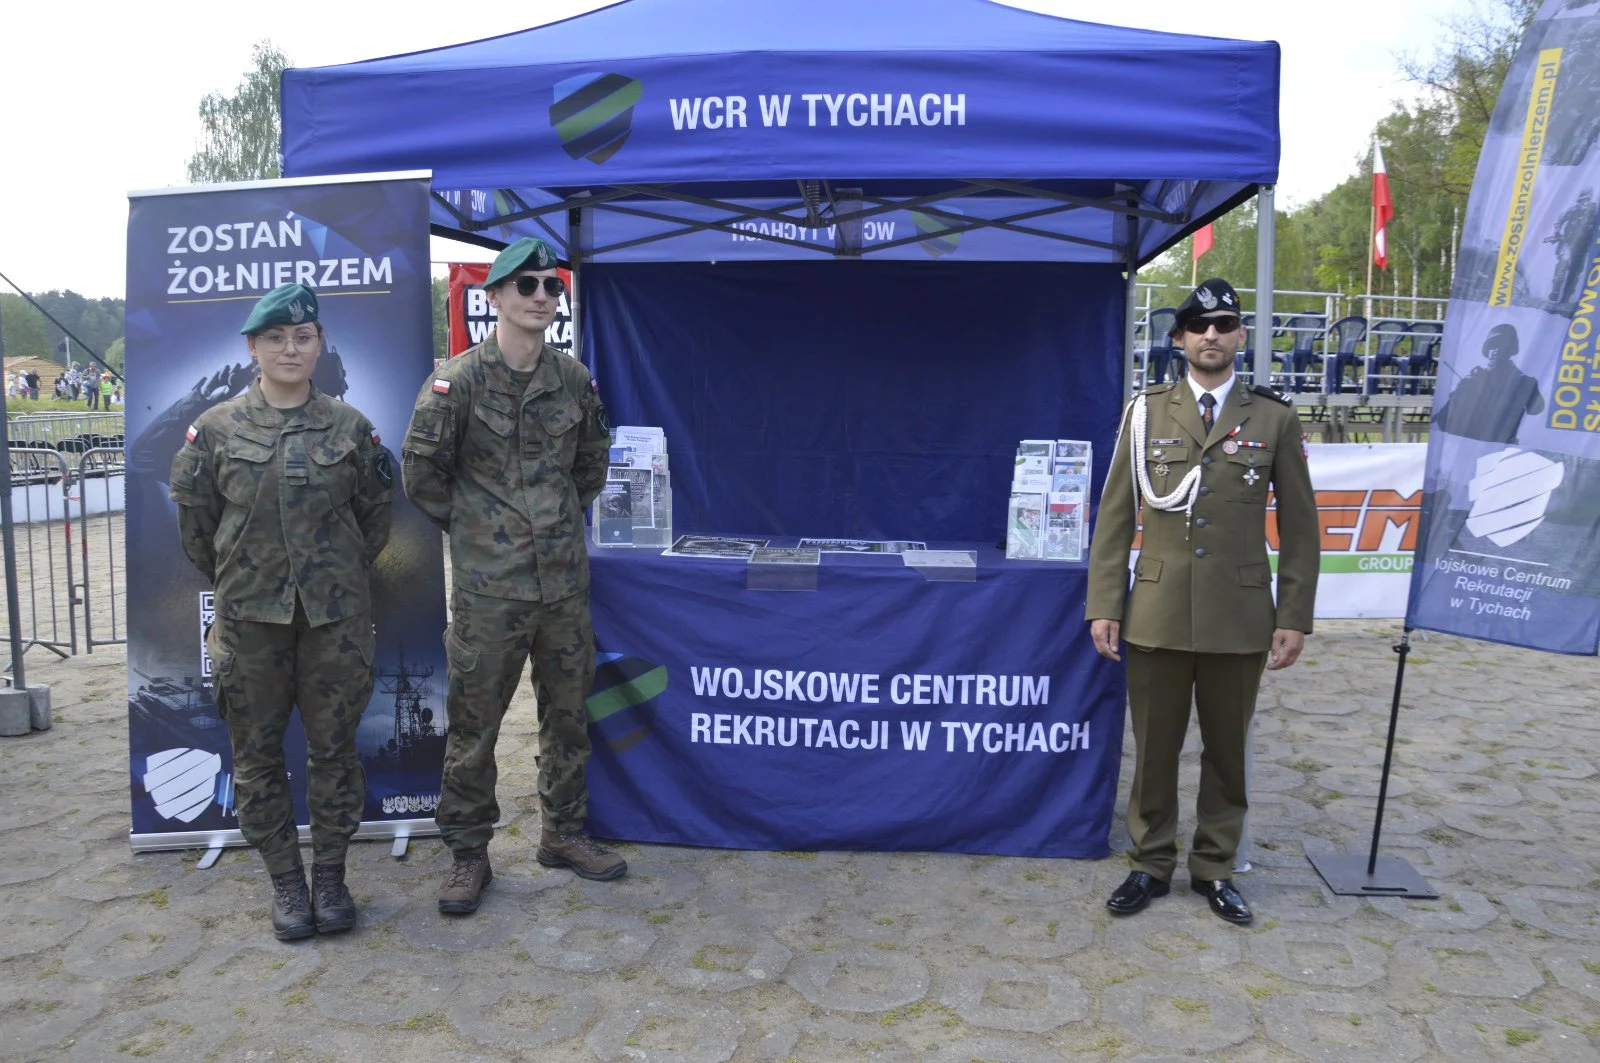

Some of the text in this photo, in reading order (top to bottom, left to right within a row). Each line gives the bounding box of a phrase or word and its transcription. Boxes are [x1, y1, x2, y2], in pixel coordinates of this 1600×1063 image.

[669, 93, 966, 131] WCR W TYCHACH
[1495, 61, 1558, 306] www.zostanzolnierzem.pl
[167, 210, 302, 254] ZOSTAŃ
[167, 256, 393, 295] ŻOŁNIERZEM
[1358, 557, 1414, 571] GROUP
[1503, 566, 1571, 590] Centrum
[1450, 596, 1532, 621] w Tychach
[1454, 576, 1534, 603] Rekrutacji
[690, 666, 1051, 707] WOJSKOWE CENTRUM
[690, 712, 1091, 753] REKRUTACJI W TYCHACH
